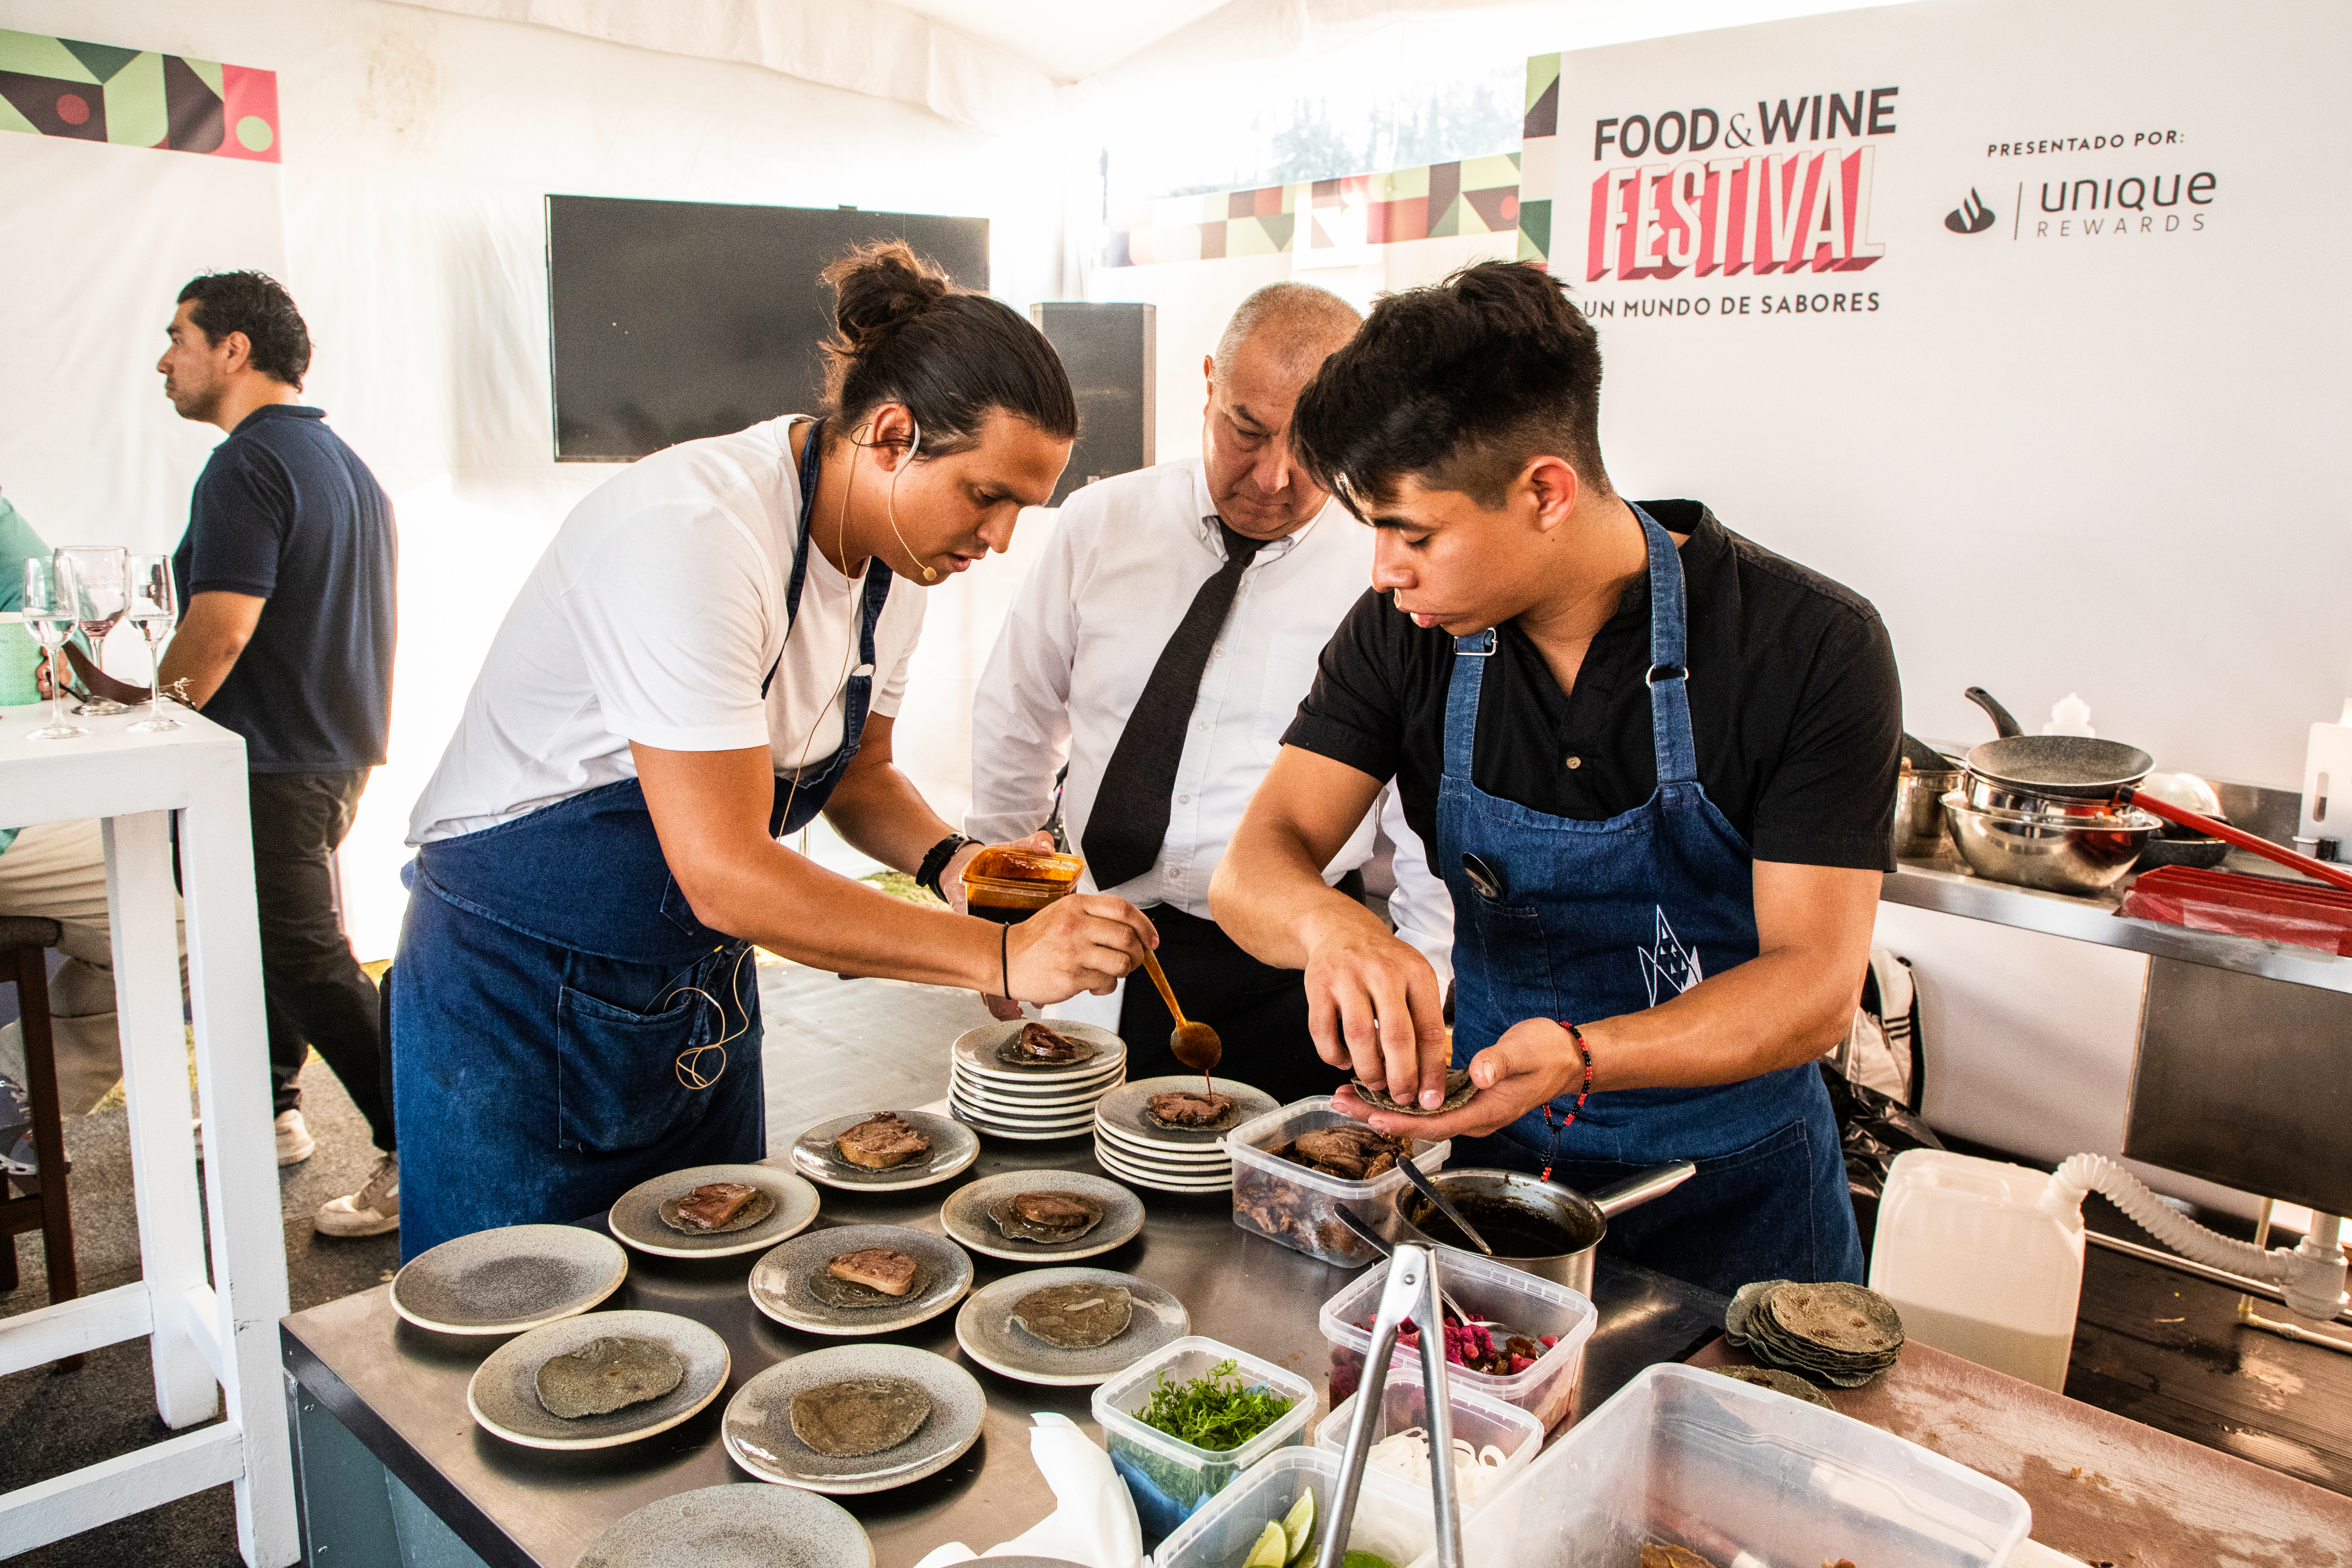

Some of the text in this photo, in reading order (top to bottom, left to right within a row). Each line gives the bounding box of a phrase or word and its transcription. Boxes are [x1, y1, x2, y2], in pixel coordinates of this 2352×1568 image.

[1987, 130, 2184, 157] PRESENTADO POR:
[1587, 145, 1886, 282] FESTIVAL
[2037, 213, 2205, 238] REWARDS
[1584, 292, 1879, 318] UN MUNDO DE SABORES
